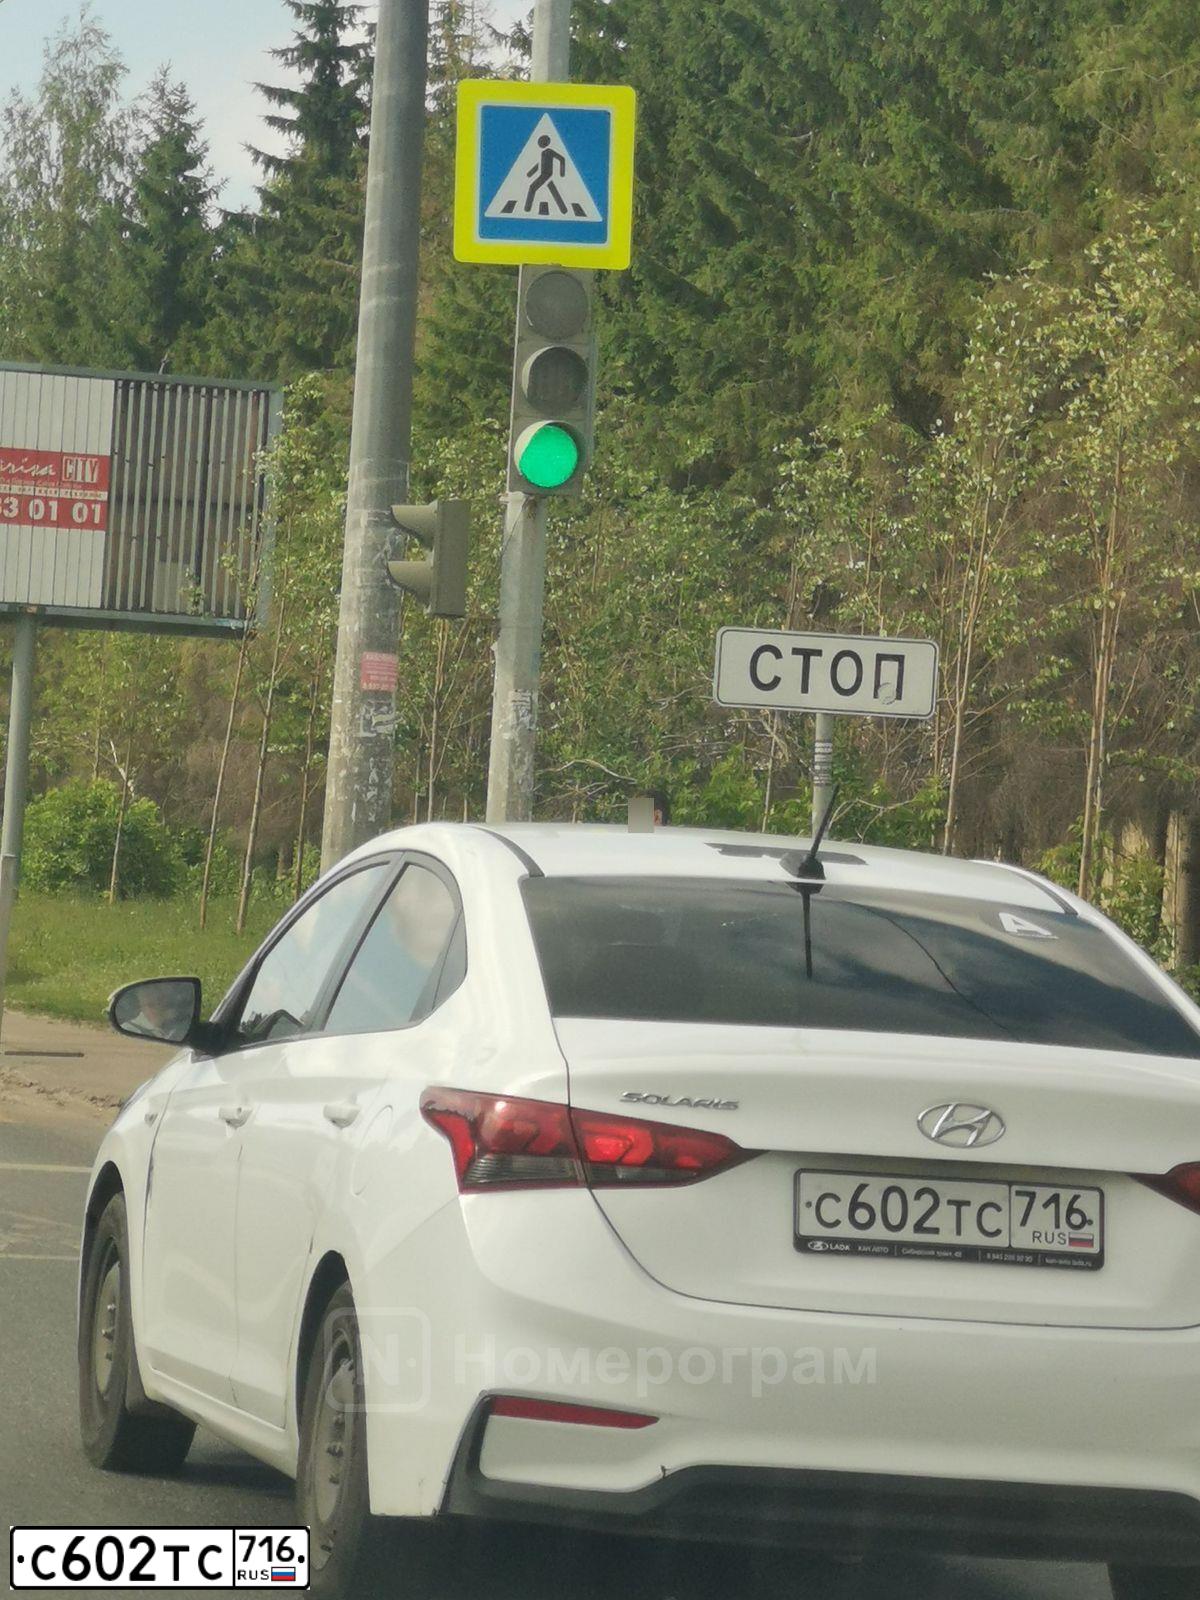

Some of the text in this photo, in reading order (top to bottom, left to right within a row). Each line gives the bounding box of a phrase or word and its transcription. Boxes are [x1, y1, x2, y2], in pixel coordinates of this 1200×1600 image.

[0, 497, 101, 524] 3 01 01
[750, 644, 905, 701] СТОП
[619, 1091, 739, 1110] SOLARIS
[814, 1183, 1088, 1238] С602ТС 716
[829, 1242, 850, 1251] LADA
[1032, 1231, 1067, 1246] RUS
